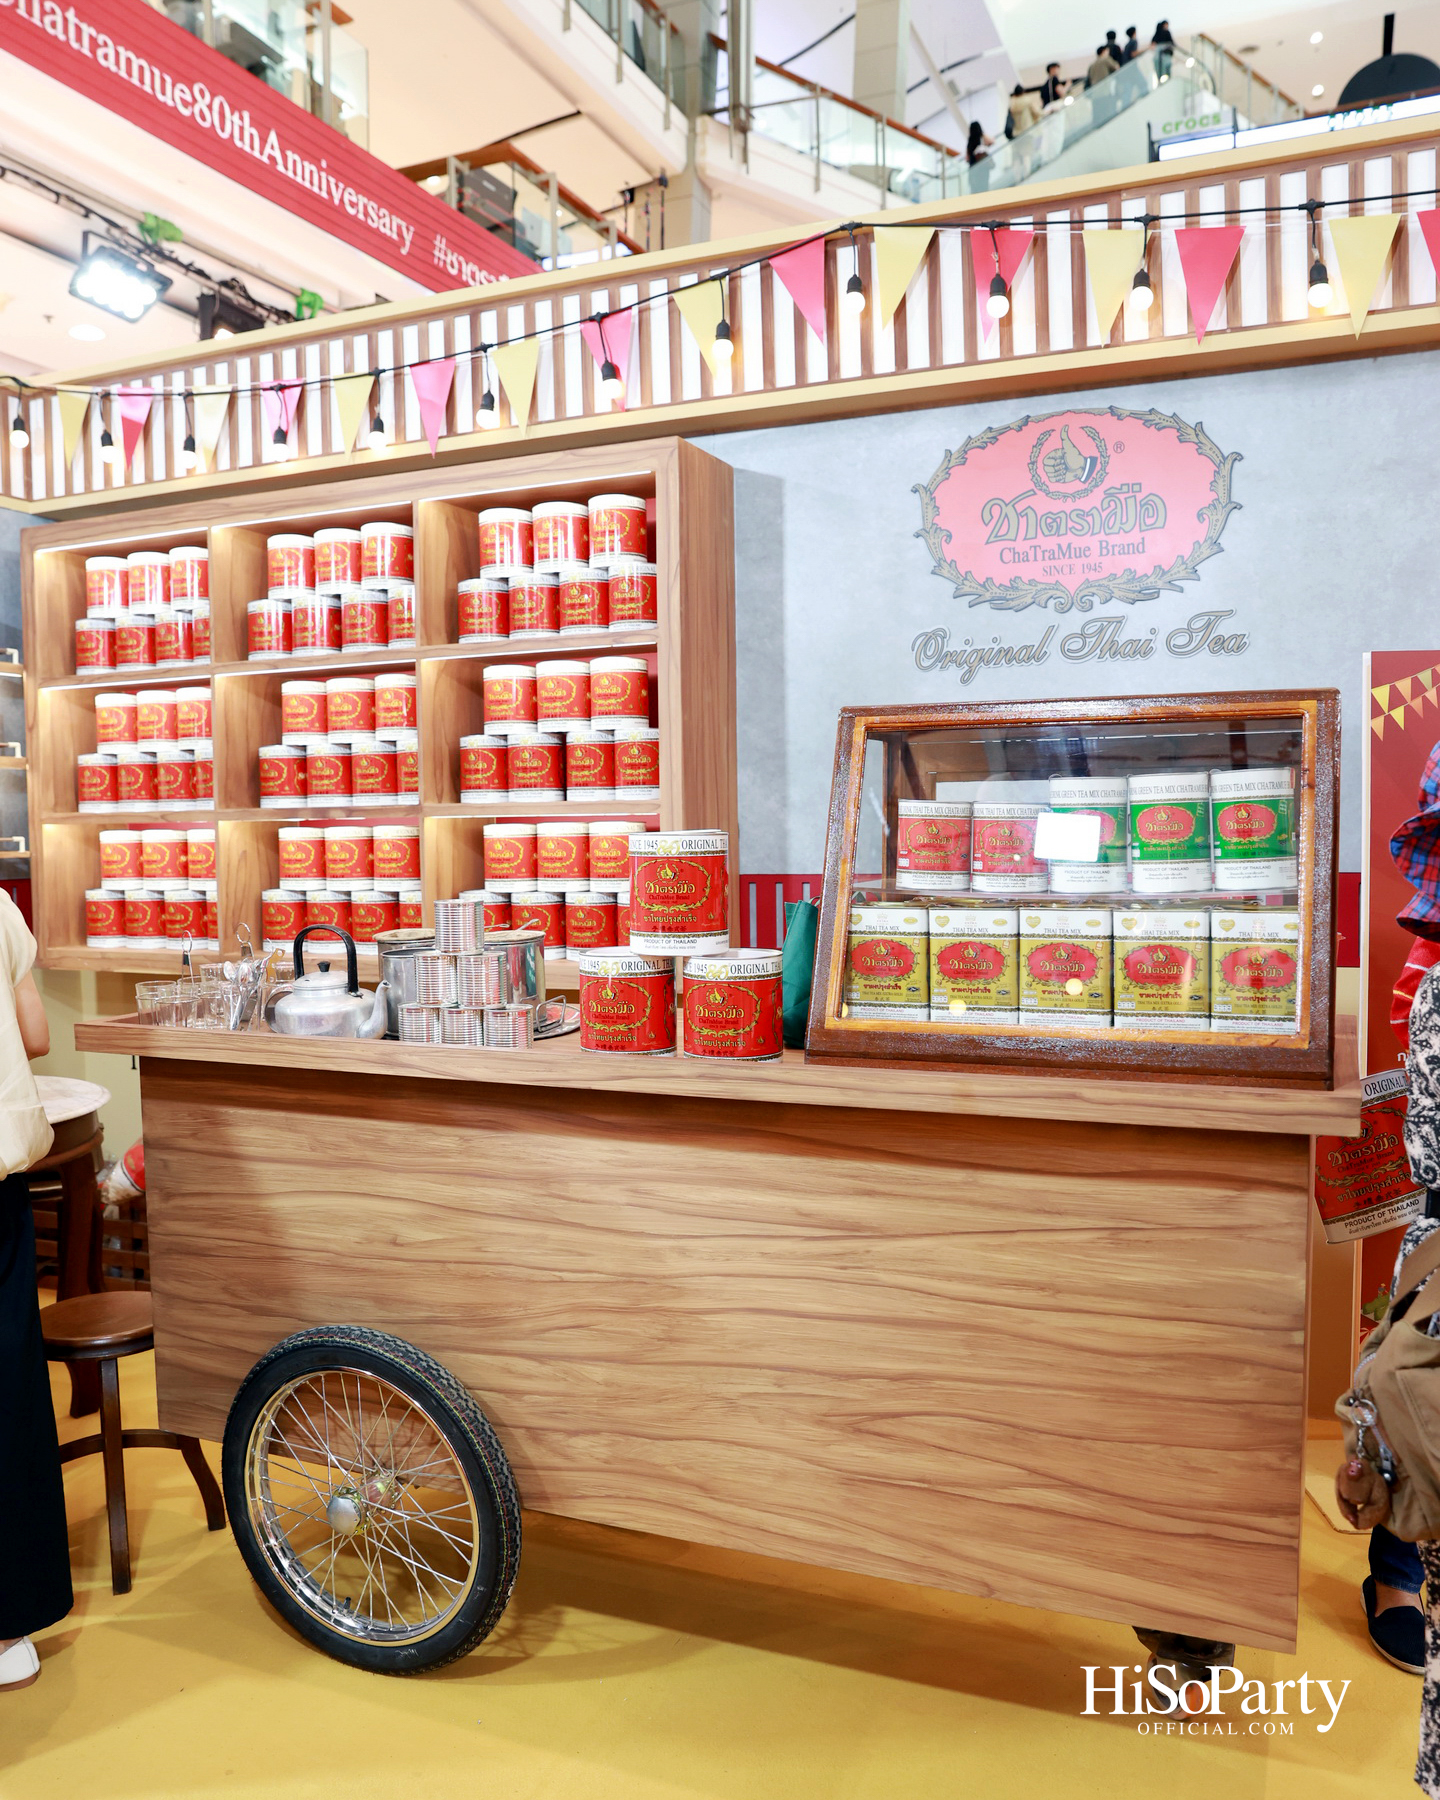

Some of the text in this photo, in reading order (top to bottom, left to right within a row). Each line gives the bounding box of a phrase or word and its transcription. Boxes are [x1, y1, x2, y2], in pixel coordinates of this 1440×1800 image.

[1161, 113, 1222, 134] crocs
[981, 482, 1168, 546] ชาตรามือ
[999, 538, 1146, 565] ChaTraMue Brand
[1042, 562, 1104, 577] SINCE 1945
[911, 608, 1249, 686] Original Thai Tea
[1078, 790, 1088, 799] TEA
[1089, 790, 1100, 798] MIX
[1153, 786, 1164, 794] TEA
[1165, 785, 1176, 794] MIX
[1233, 783, 1244, 792] TEA
[1245, 782, 1256, 791] MIX
[644, 839, 658, 850] 1945
[681, 839, 719, 850] ORIGINAL
[645, 879, 696, 894] ชาตรามือ
[621, 959, 660, 971] ORIGINAL
[693, 963, 708, 973] 1945
[730, 962, 770, 975] ORIGINAL
[589, 999, 635, 1014] ชาตรามือ
[695, 1004, 745, 1019] ชาตรามือ
[1364, 1075, 1404, 1097] ORIGINAL
[1327, 1132, 1399, 1167] ชาตรามือ
[1344, 1198, 1420, 1228] PRODUCT OF THAILAND
